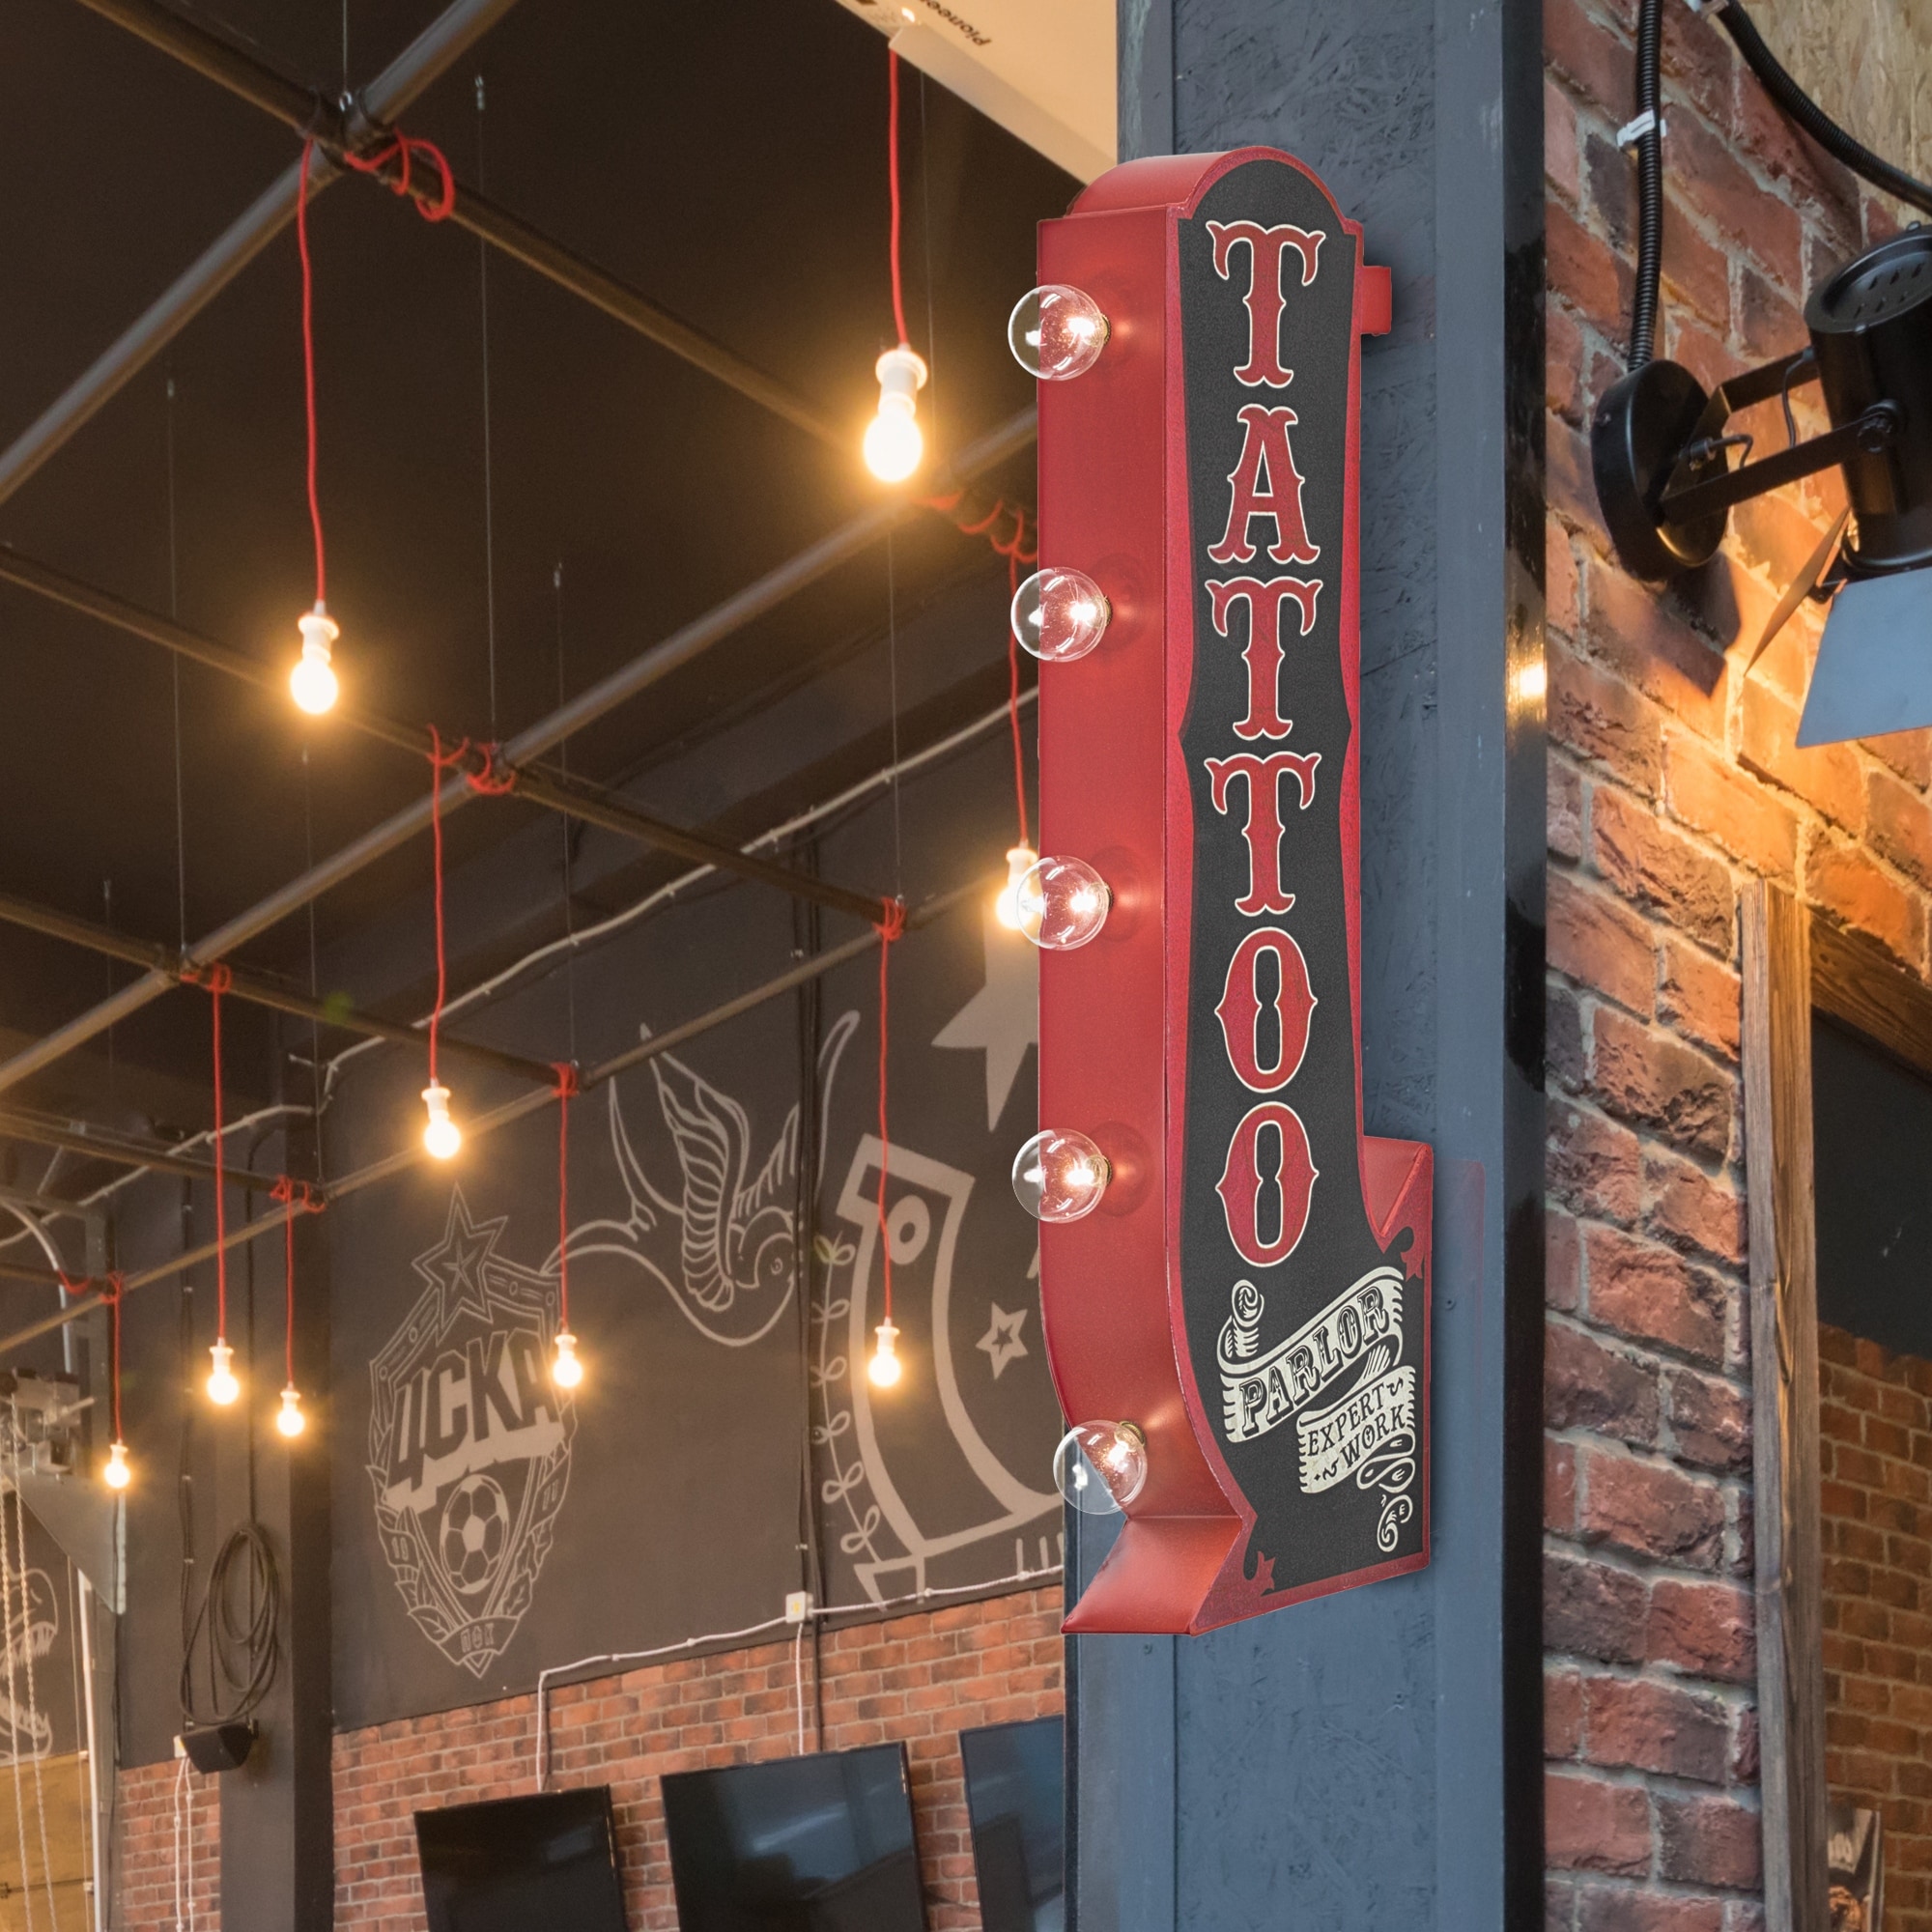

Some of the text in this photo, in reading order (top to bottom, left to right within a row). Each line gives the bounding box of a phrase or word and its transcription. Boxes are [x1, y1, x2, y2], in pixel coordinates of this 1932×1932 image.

[920, 0, 991, 46] Pionee
[1205, 220, 1326, 1267] TATTOO
[386, 1327, 560, 1493] ЦСКА
[1239, 1286, 1390, 1438] PARLOR
[1307, 1381, 1386, 1458] EXPERT
[1340, 1403, 1406, 1469] WORK
